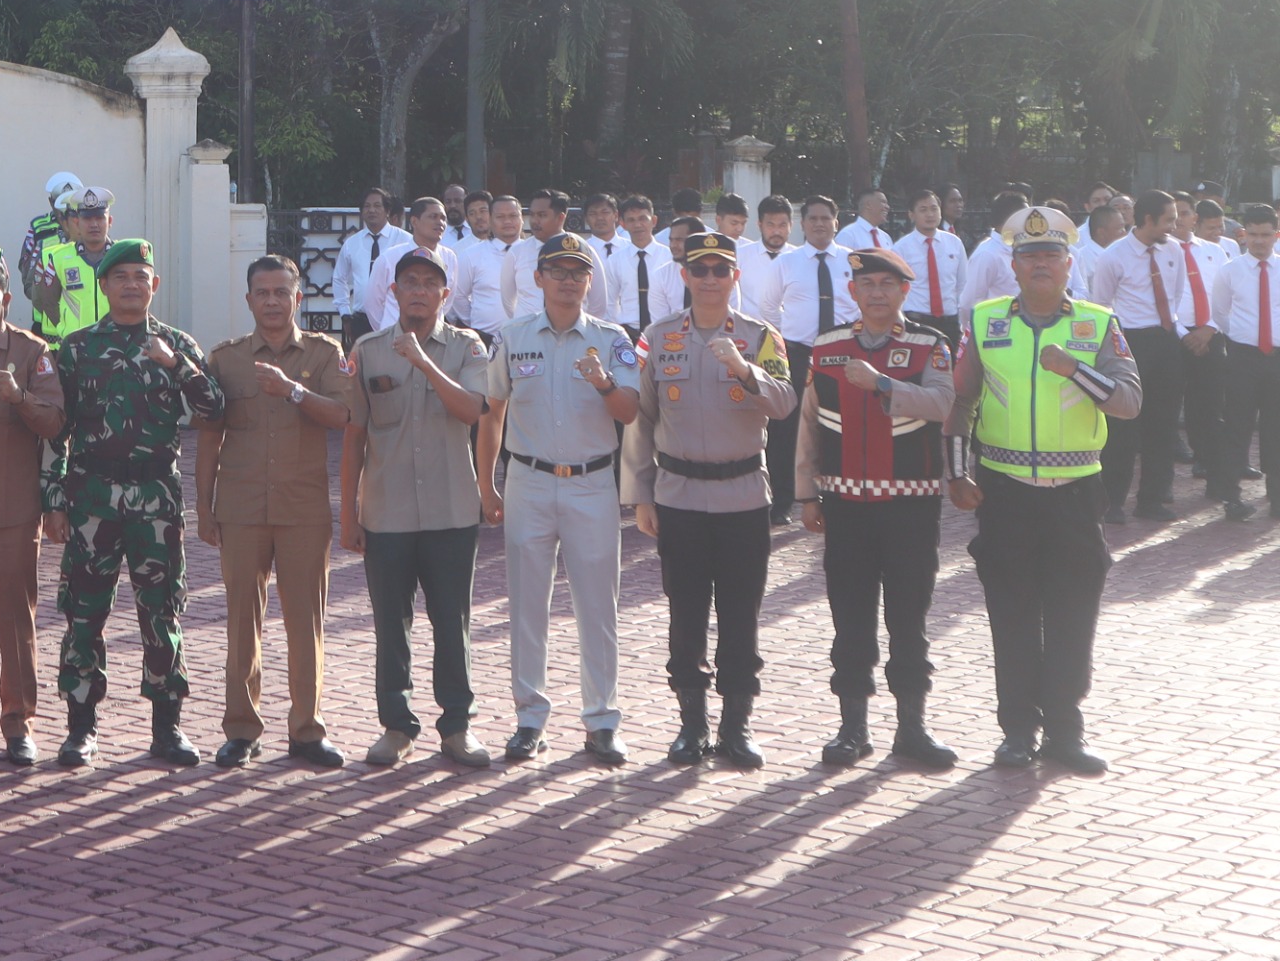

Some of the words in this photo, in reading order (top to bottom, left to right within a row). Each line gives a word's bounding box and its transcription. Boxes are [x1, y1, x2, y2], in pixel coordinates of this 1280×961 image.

[1069, 342, 1098, 351] POLRI
[510, 351, 544, 361] PUTRA
[659, 354, 688, 363] RAFI
